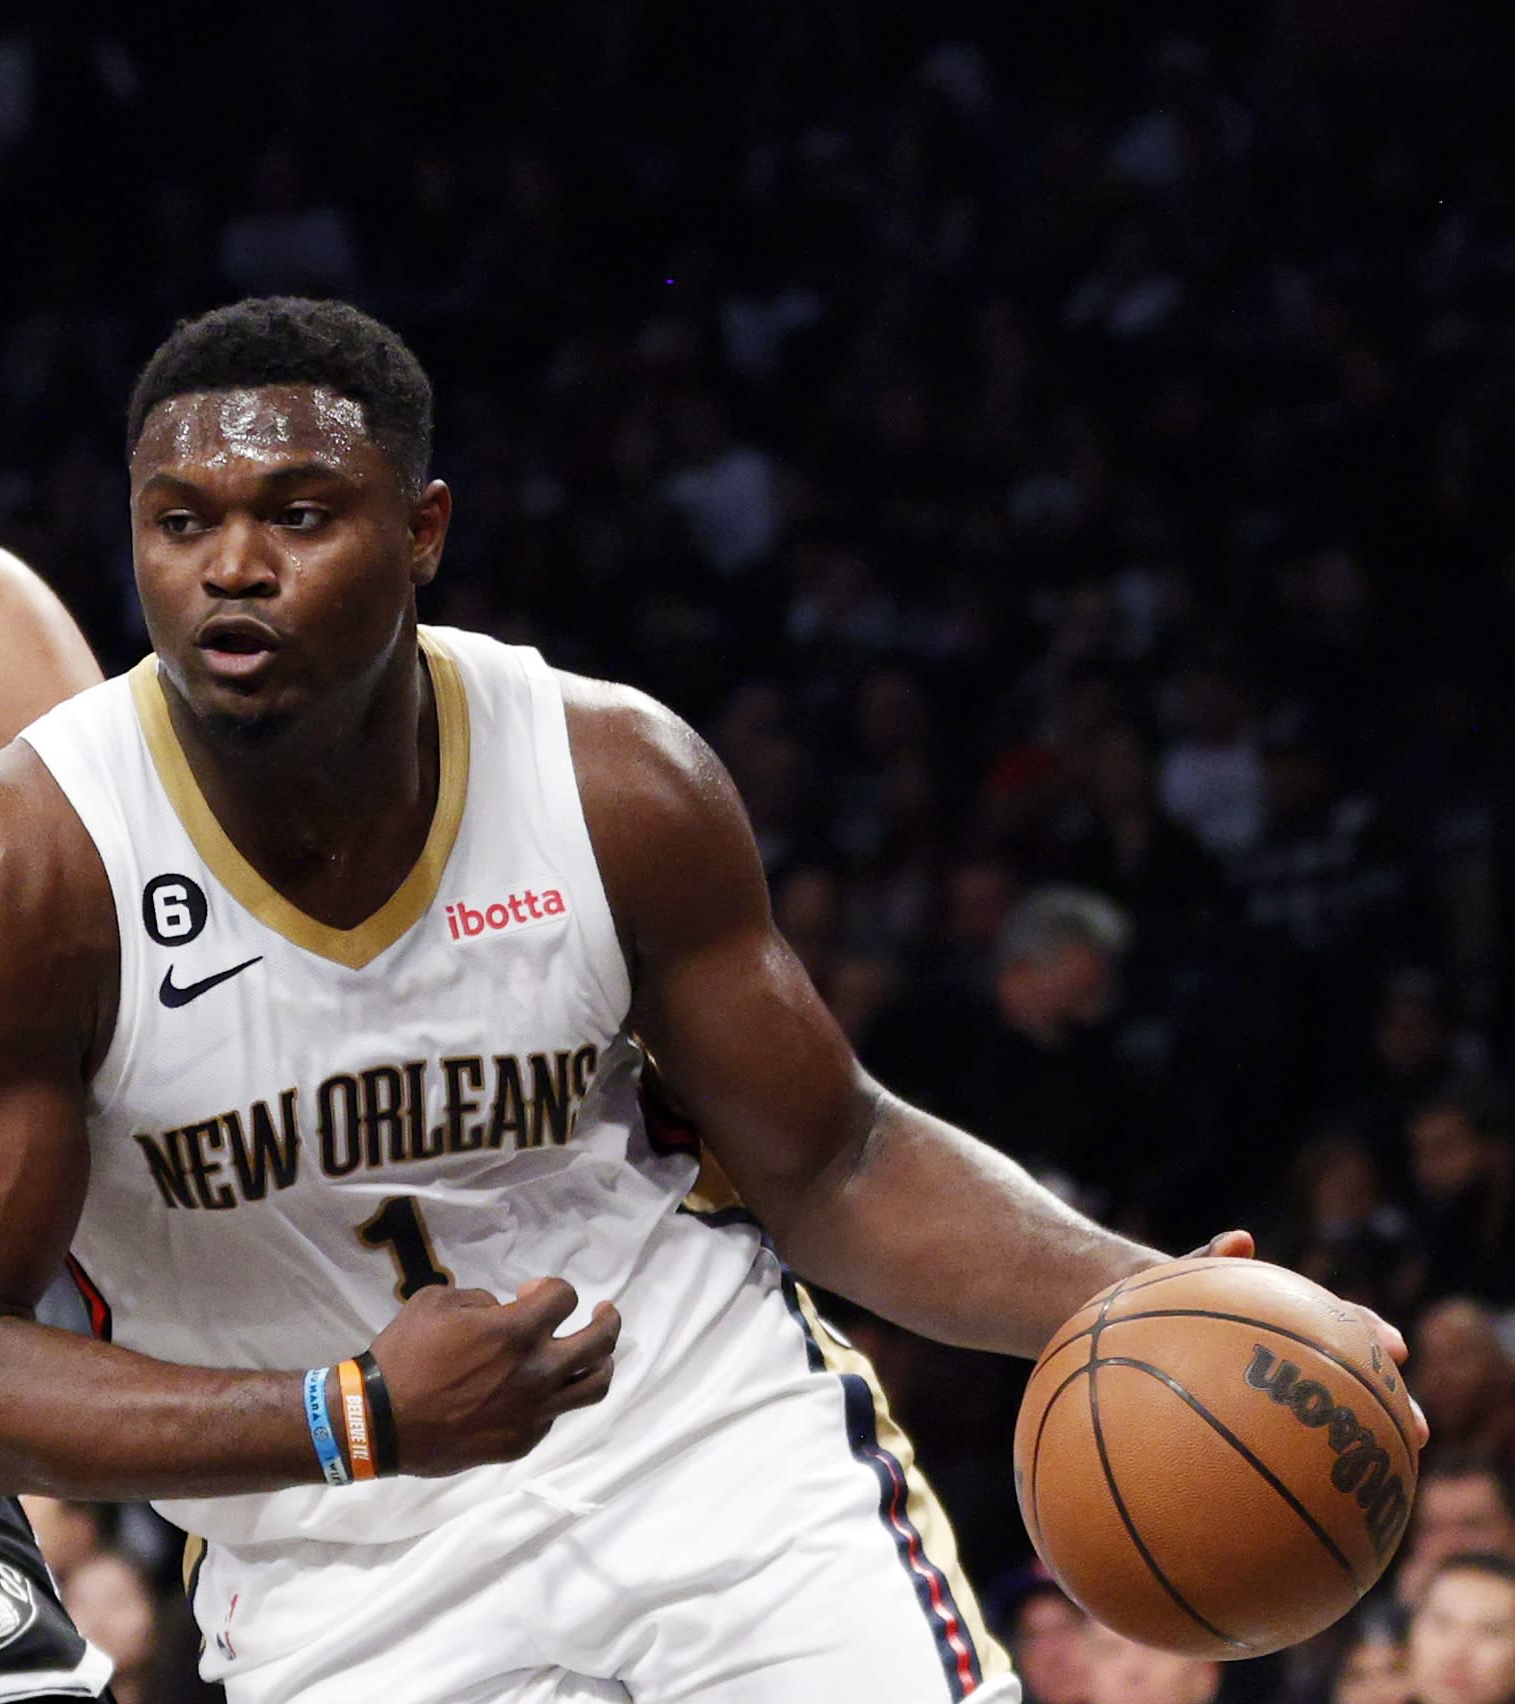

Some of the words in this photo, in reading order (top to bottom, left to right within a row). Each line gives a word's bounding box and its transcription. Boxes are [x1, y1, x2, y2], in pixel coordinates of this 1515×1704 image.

[153, 883, 189, 938] 6
[445, 889, 566, 940] ibotta
[133, 1087, 302, 1210] NEW
[355, 1195, 456, 1301] 1
[346, 1394, 367, 1442] BELIEVE
